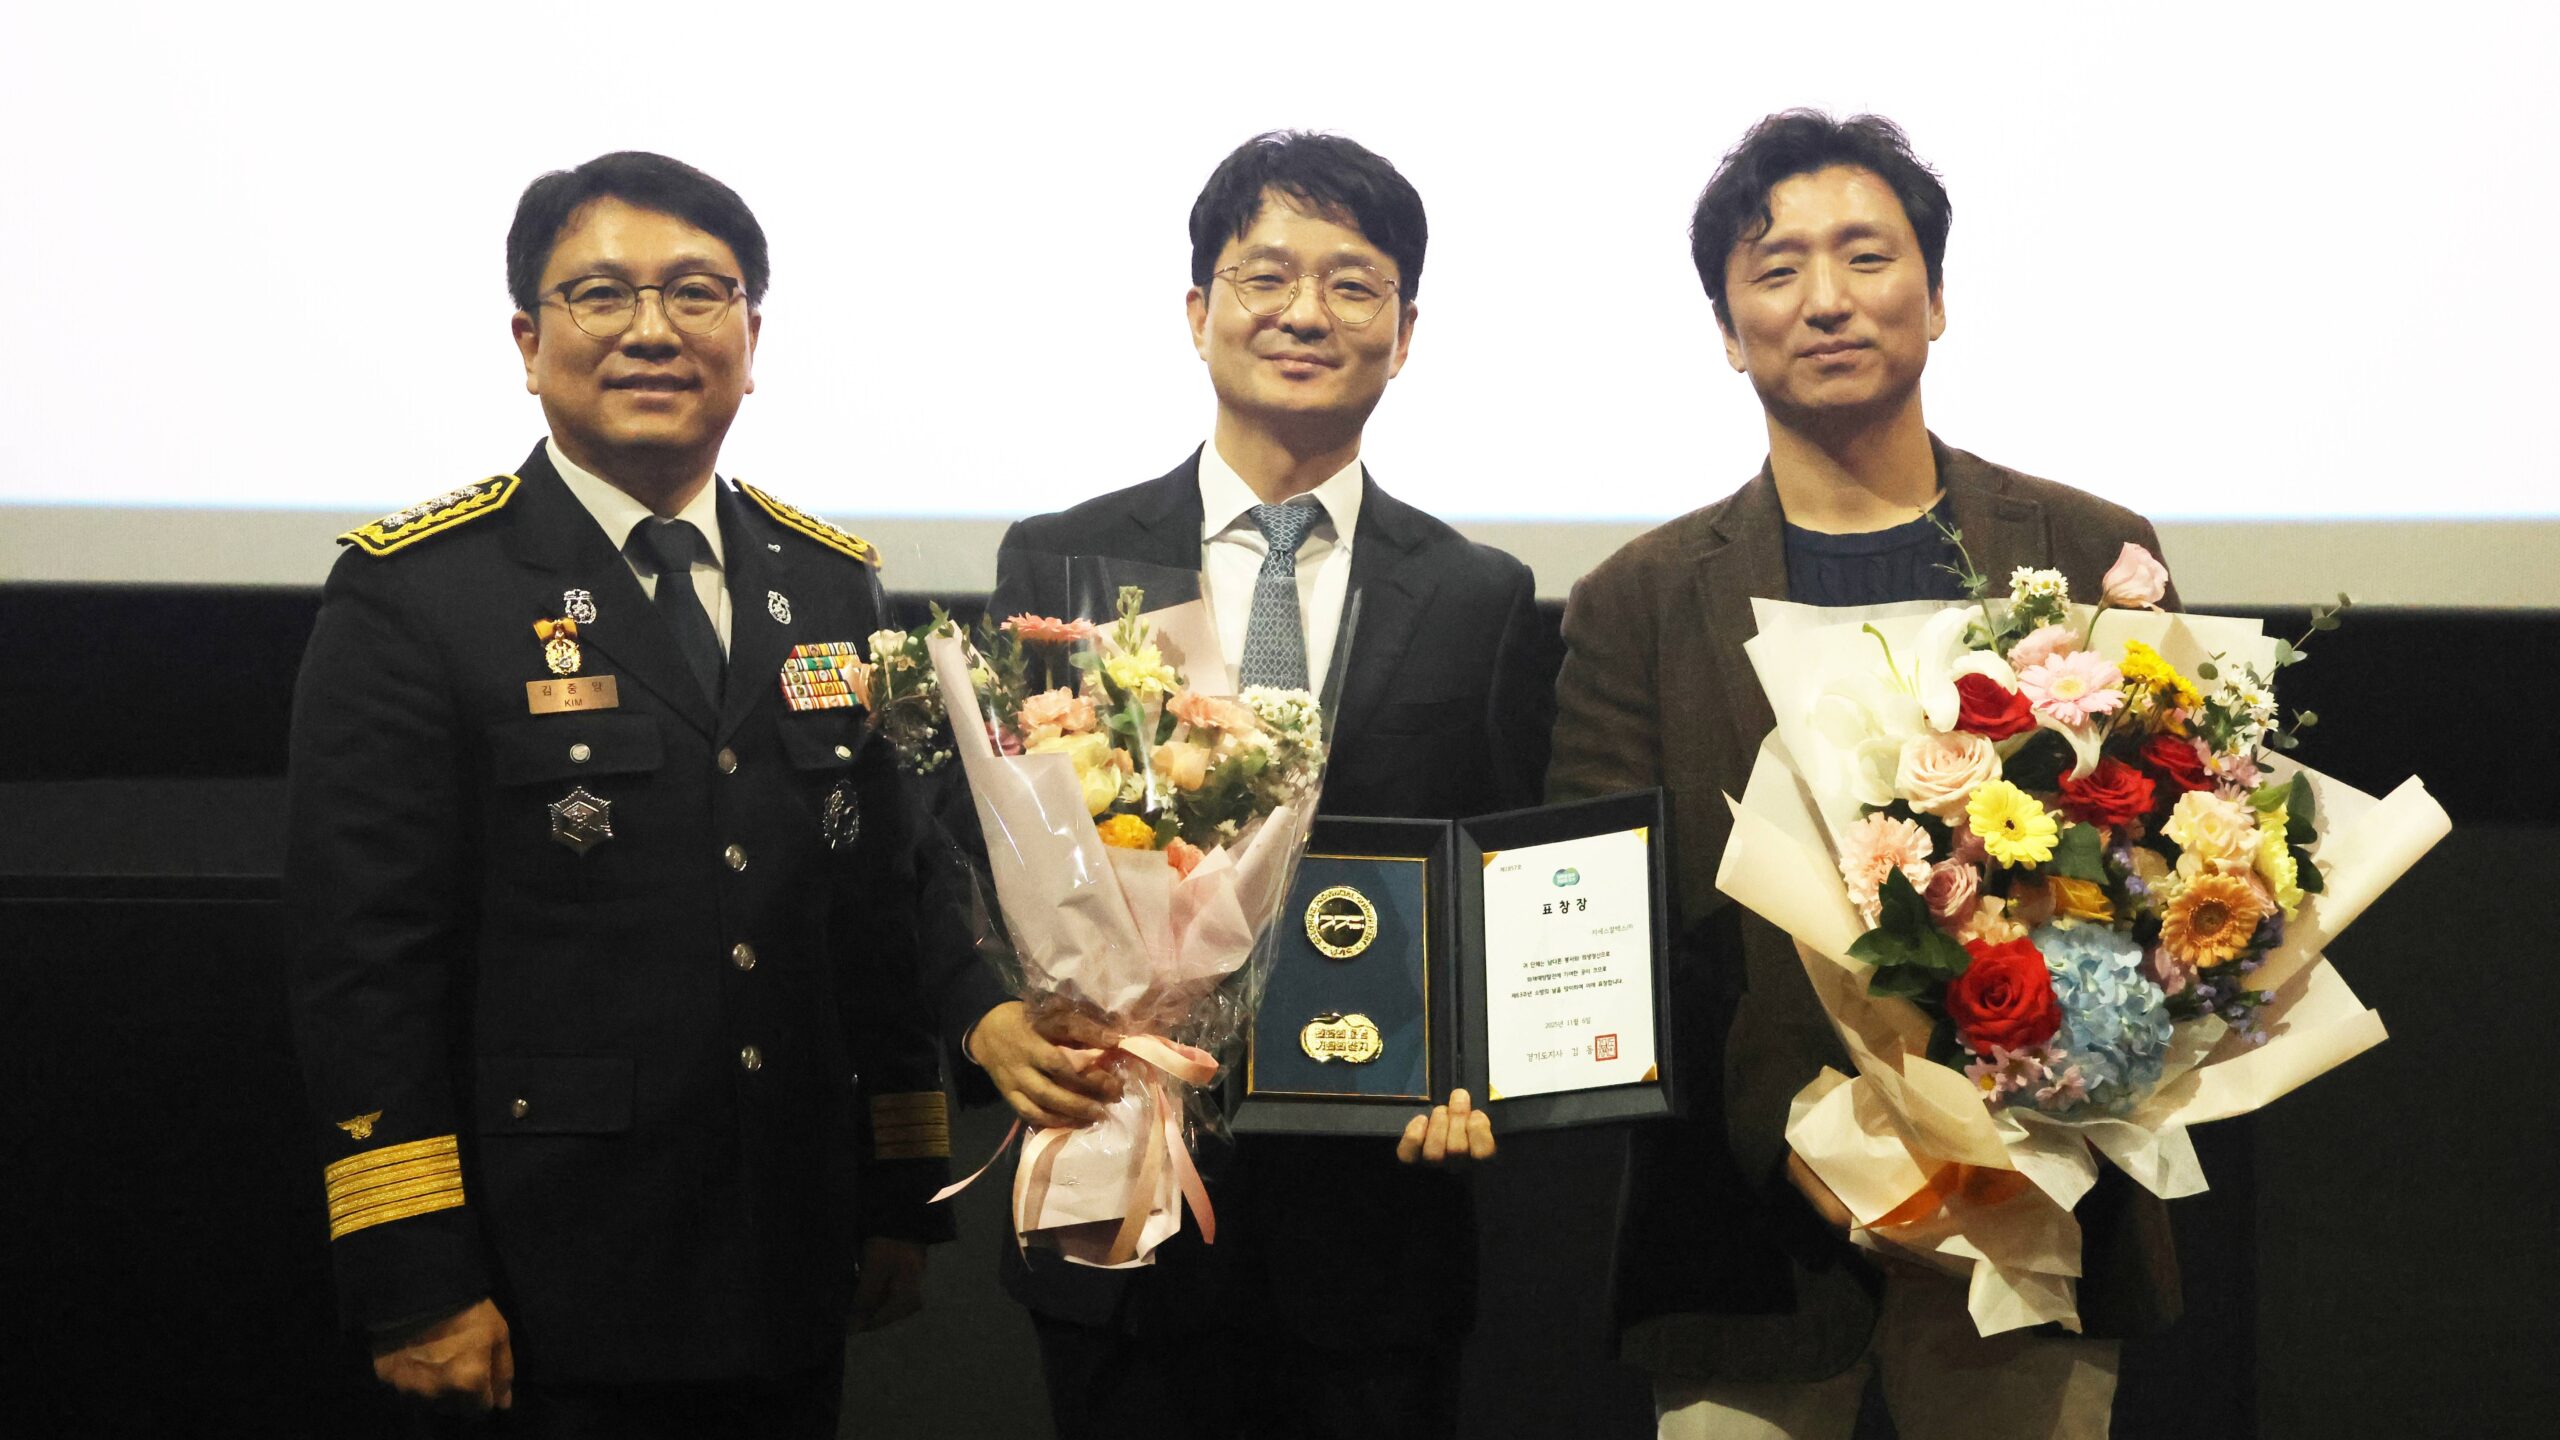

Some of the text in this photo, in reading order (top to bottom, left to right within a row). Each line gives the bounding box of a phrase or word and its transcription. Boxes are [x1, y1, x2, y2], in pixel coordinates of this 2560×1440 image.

[541, 685, 552, 696] 김
[564, 698, 583, 707] KIM
[1526, 1049, 1563, 1063] 경기도지사
